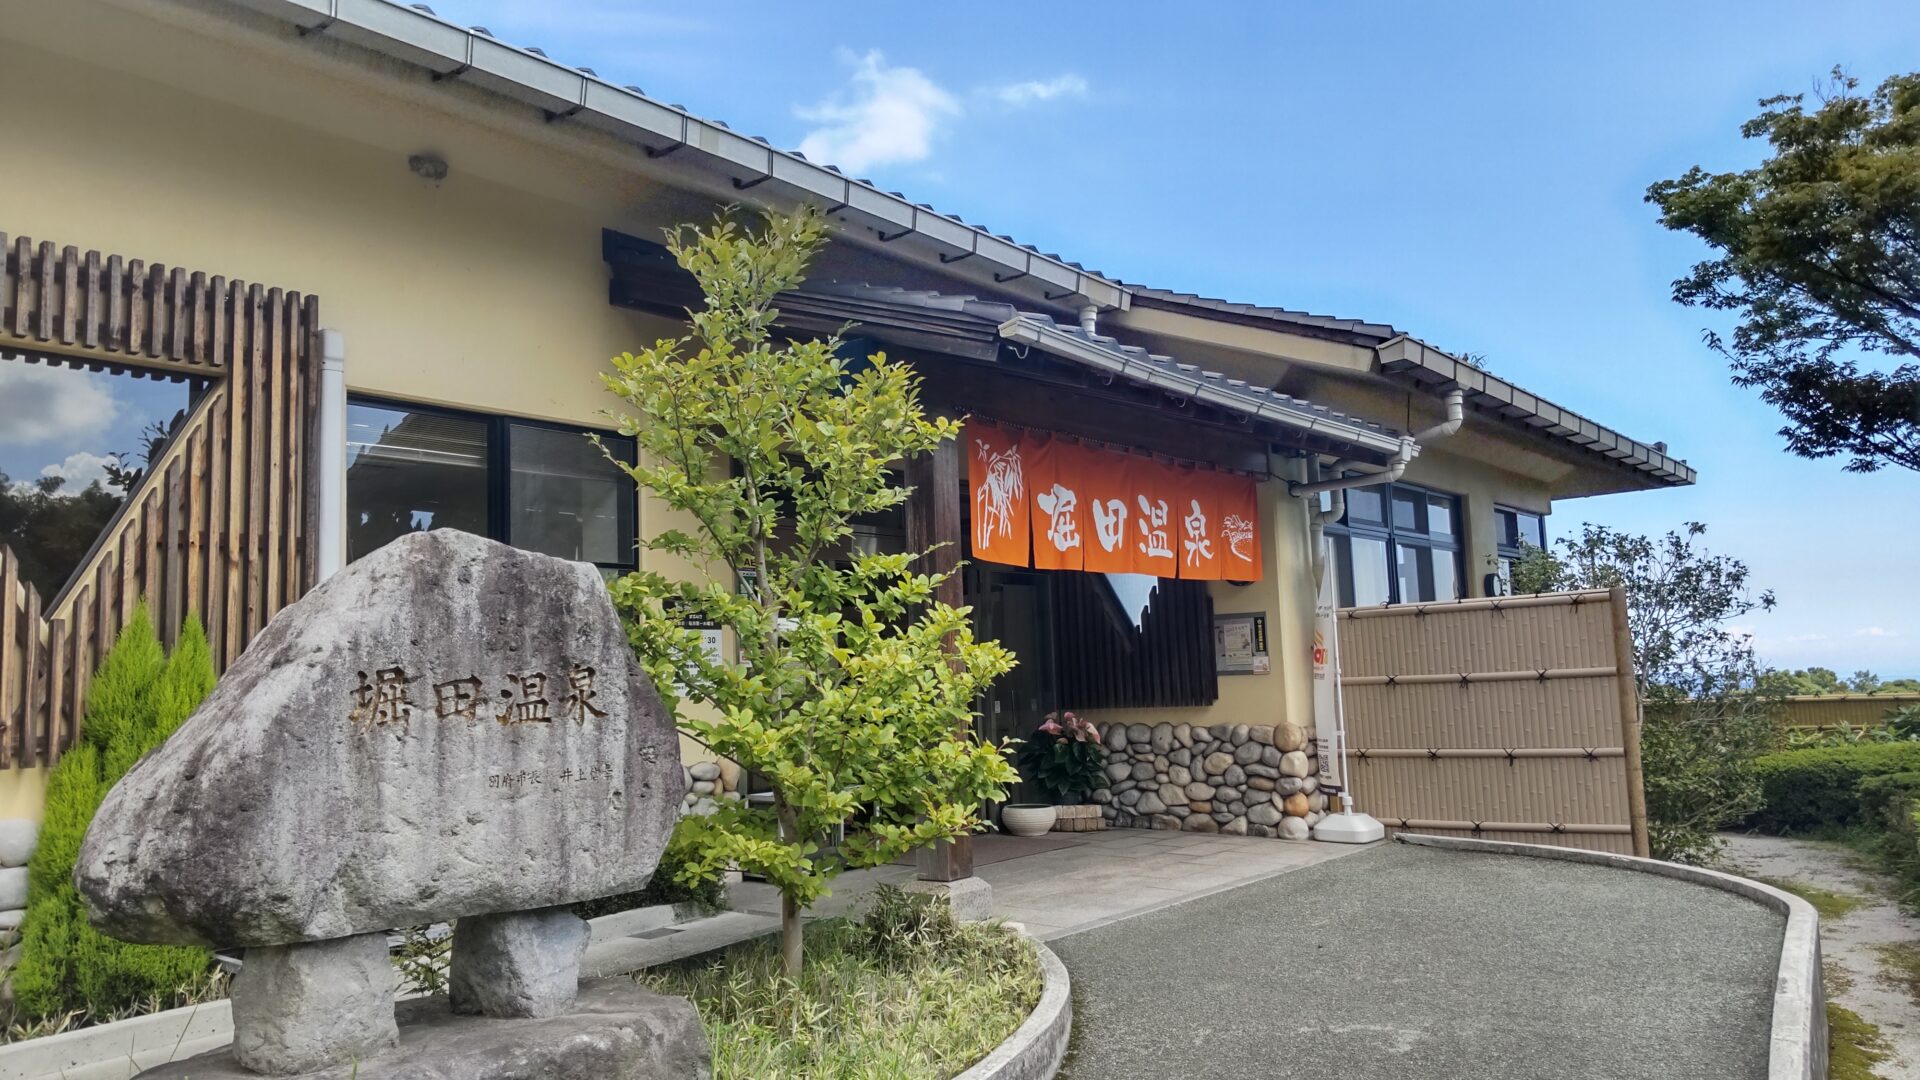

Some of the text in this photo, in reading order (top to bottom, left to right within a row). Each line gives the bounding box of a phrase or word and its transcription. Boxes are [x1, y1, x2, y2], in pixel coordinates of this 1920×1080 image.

[1037, 483, 1214, 568] 堀田温泉
[348, 662, 609, 736] 堀田温泉
